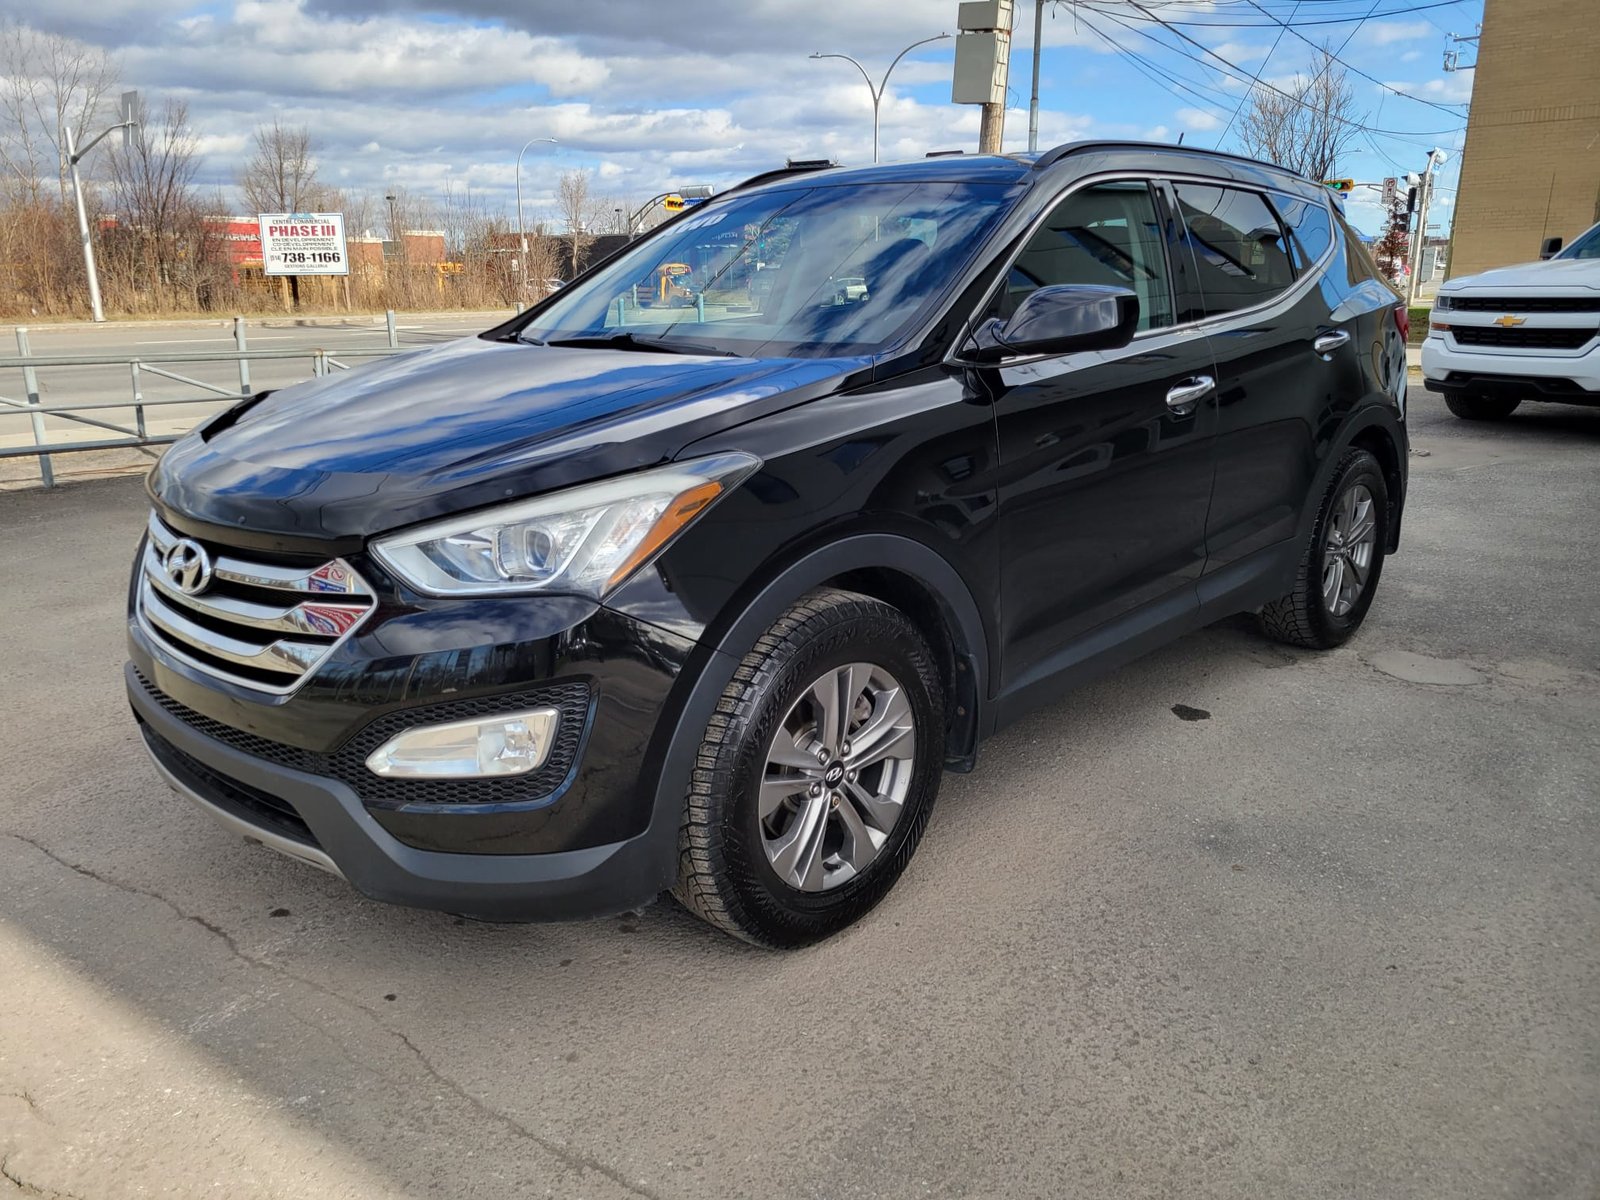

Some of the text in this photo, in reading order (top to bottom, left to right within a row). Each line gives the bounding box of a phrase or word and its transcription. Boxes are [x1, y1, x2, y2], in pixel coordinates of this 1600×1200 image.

[269, 225, 336, 237] PHASE III
[281, 252, 341, 263] 738-1166
